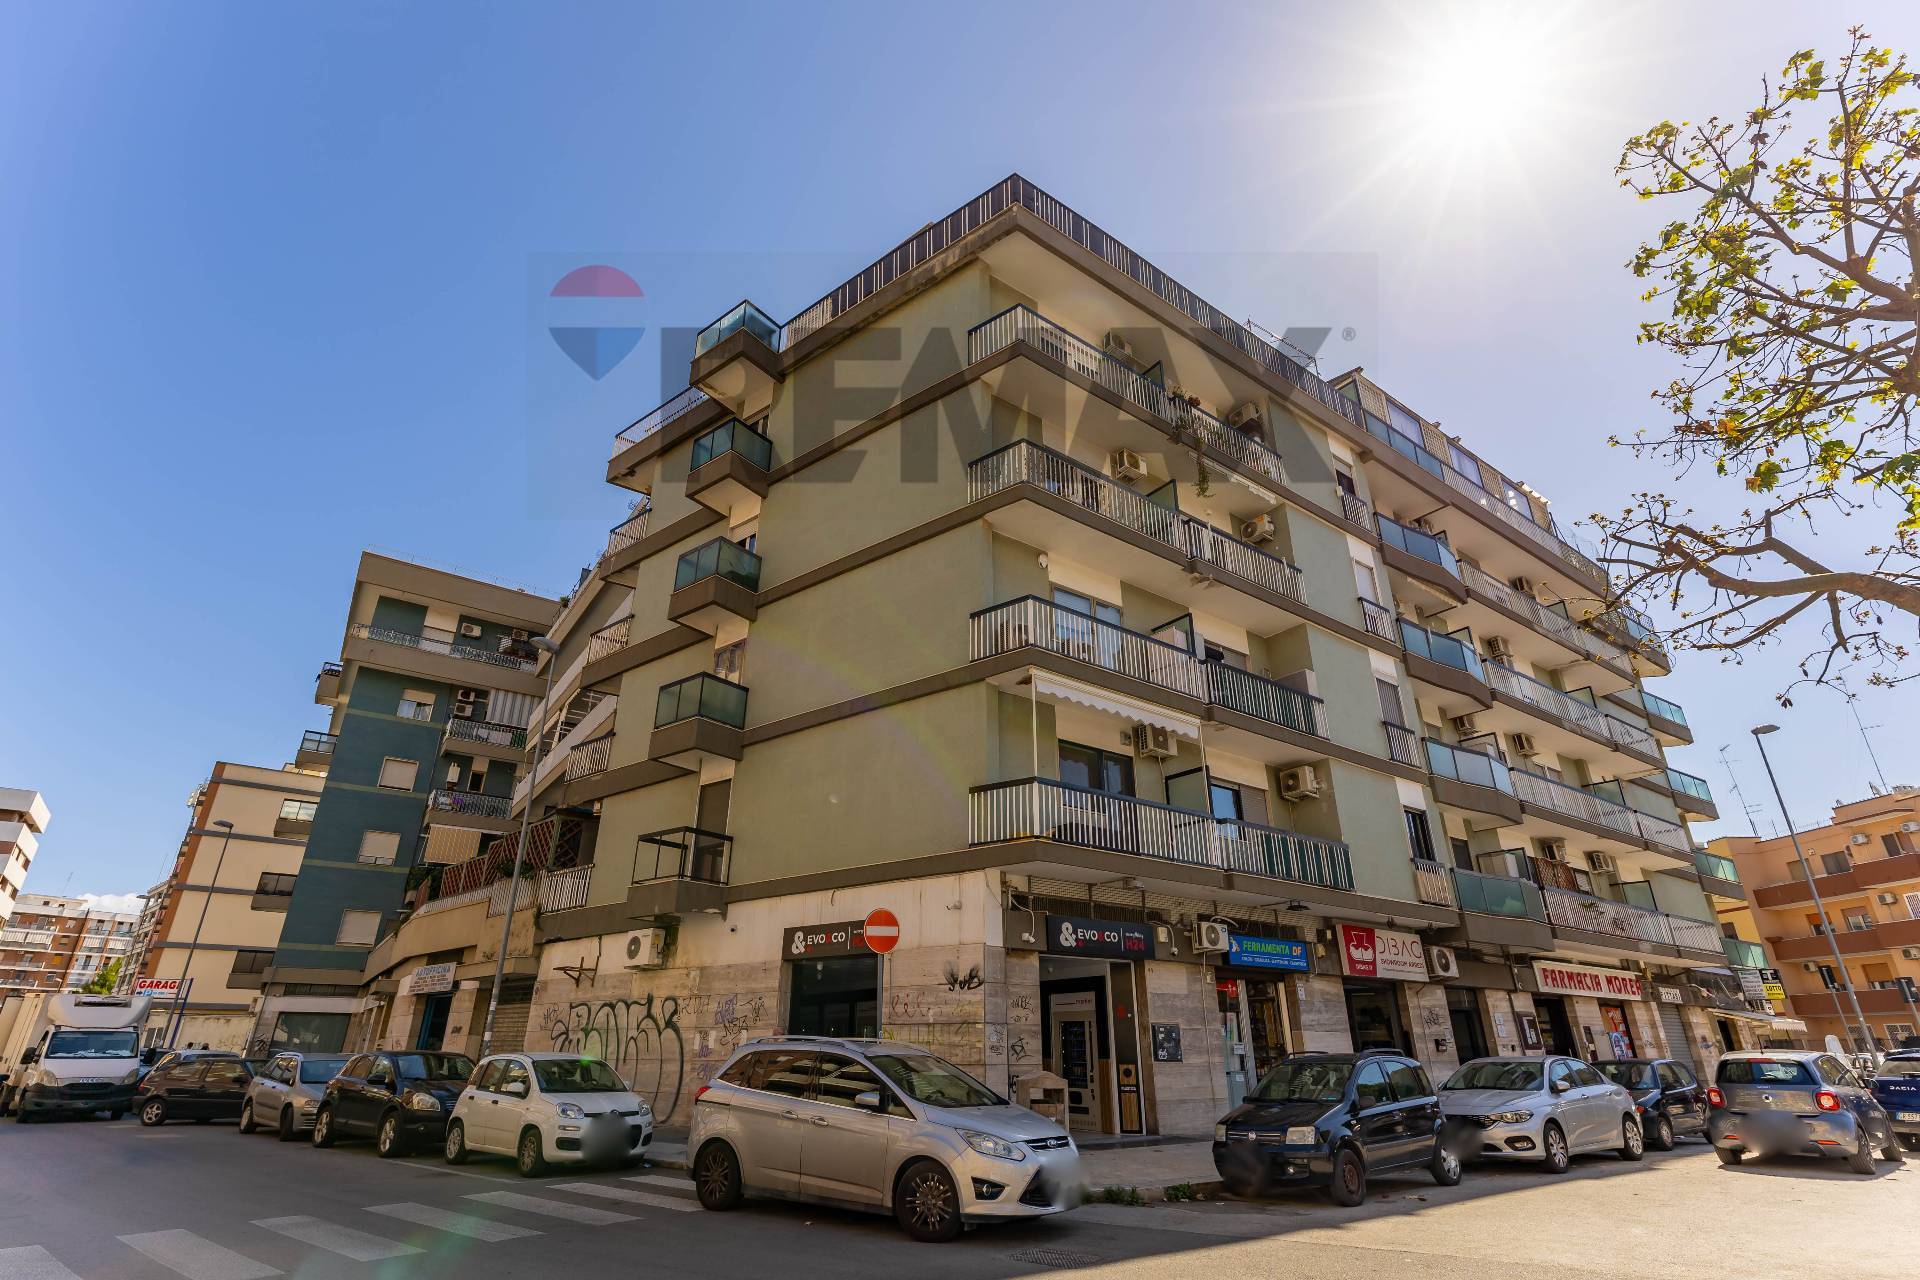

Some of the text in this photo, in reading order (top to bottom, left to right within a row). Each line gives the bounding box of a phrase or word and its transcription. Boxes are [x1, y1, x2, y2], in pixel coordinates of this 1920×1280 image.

[1242, 940, 1303, 956] FERRAMENTA DF
[138, 980, 181, 990] GARAG
[1541, 967, 1642, 996] FARMACIA MOREA
